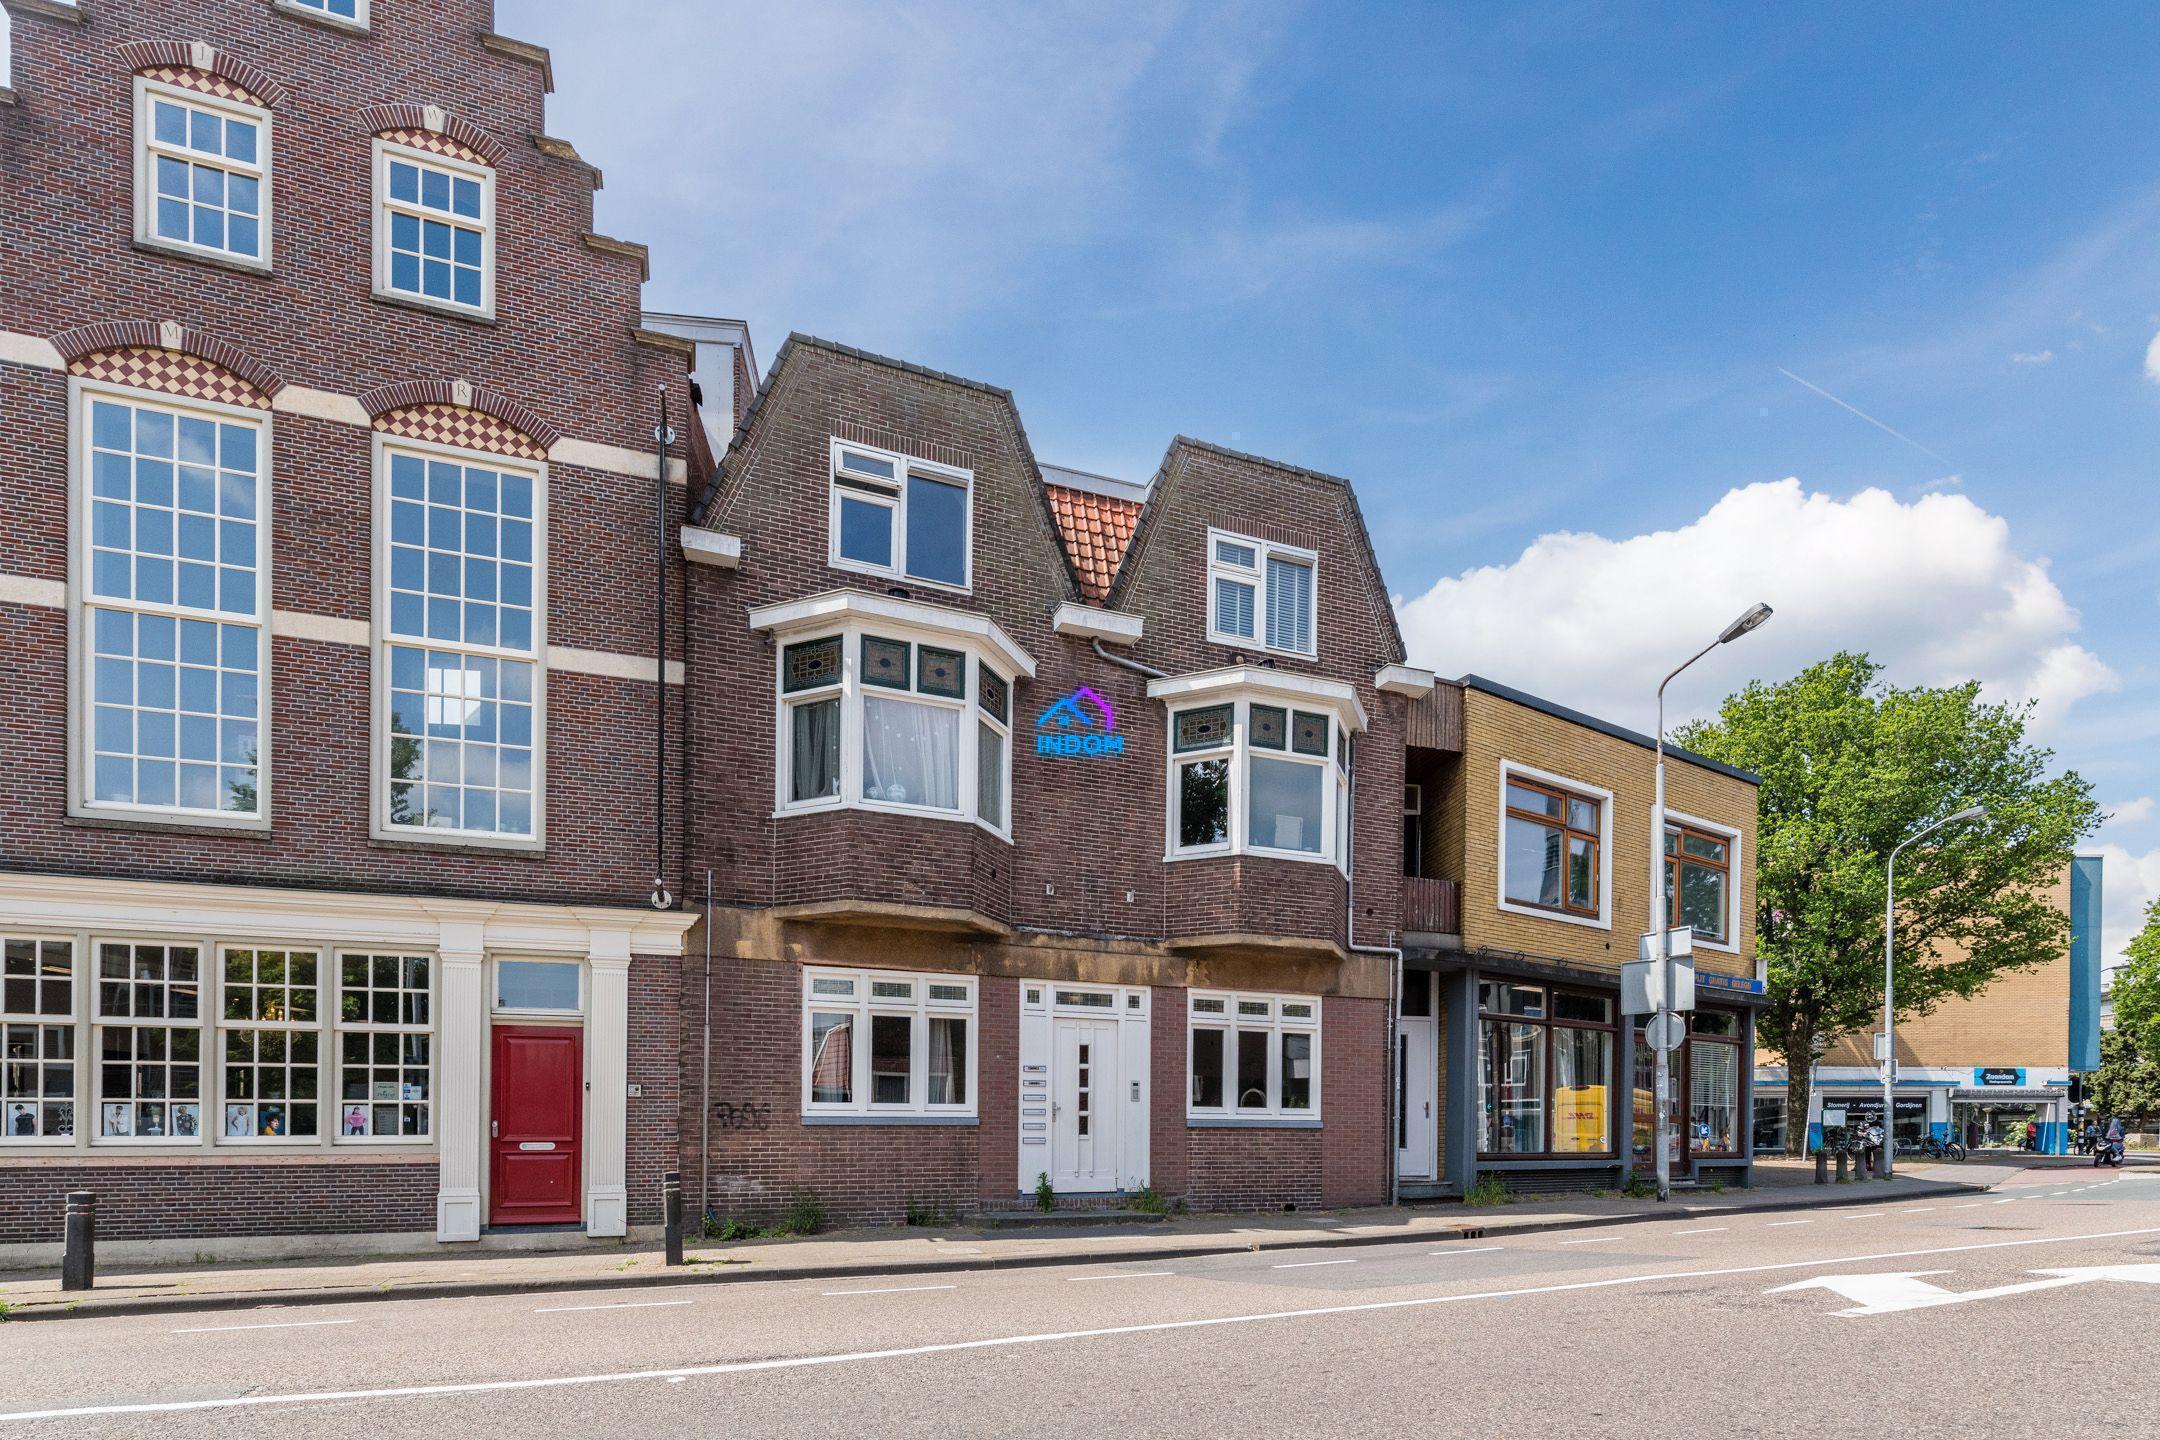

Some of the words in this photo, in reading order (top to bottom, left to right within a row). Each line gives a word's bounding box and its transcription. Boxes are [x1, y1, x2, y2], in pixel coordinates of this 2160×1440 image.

[426, 107, 442, 121] W
[163, 323, 179, 340] M
[456, 383, 469, 398] R
